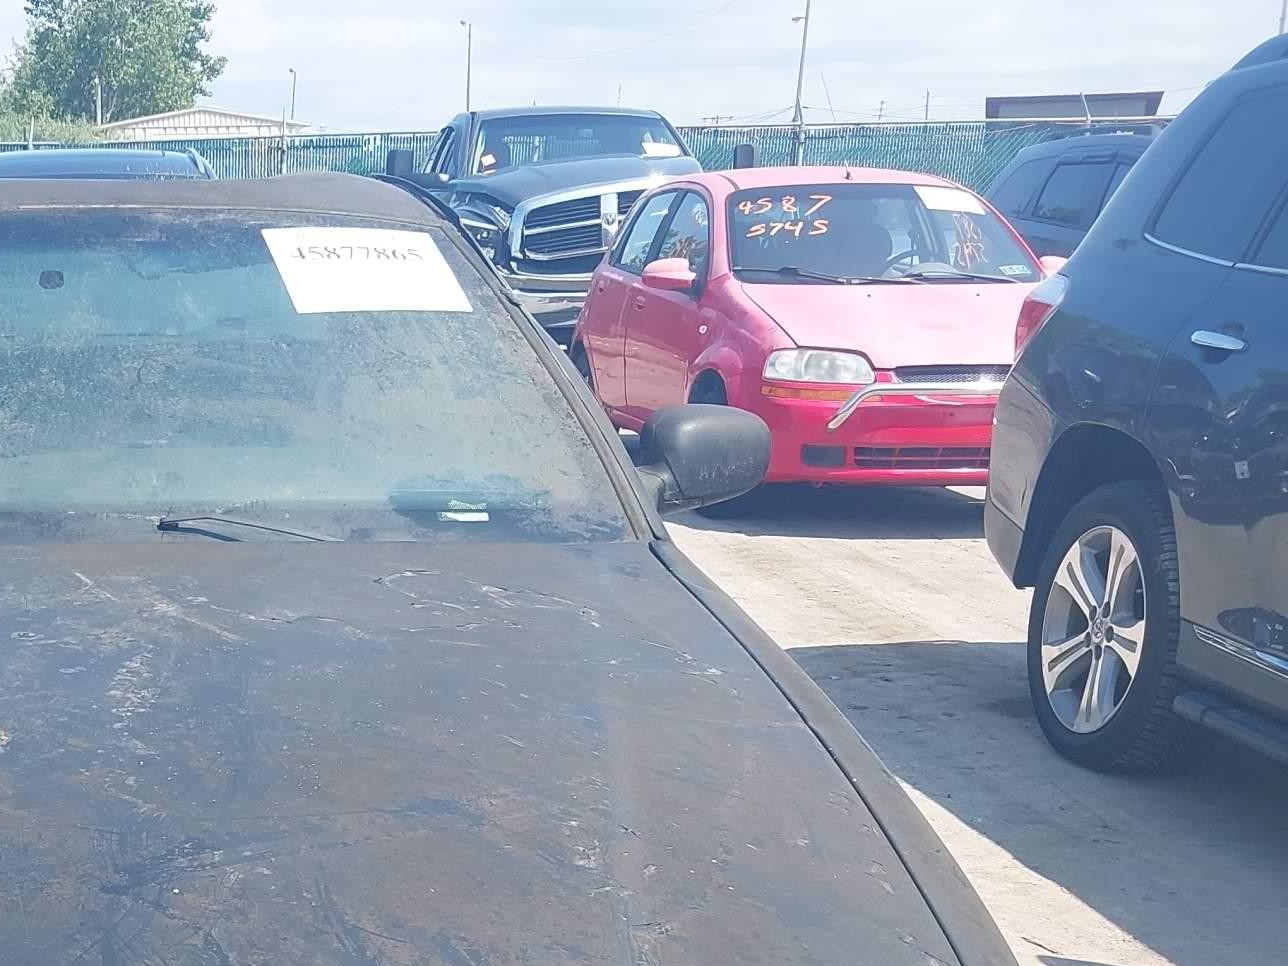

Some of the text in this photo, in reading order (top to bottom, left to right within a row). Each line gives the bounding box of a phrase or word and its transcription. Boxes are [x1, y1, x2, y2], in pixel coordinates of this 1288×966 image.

[738, 194, 832, 217] 4587
[745, 219, 829, 238] 5745
[291, 245, 424, 262] 45877865
